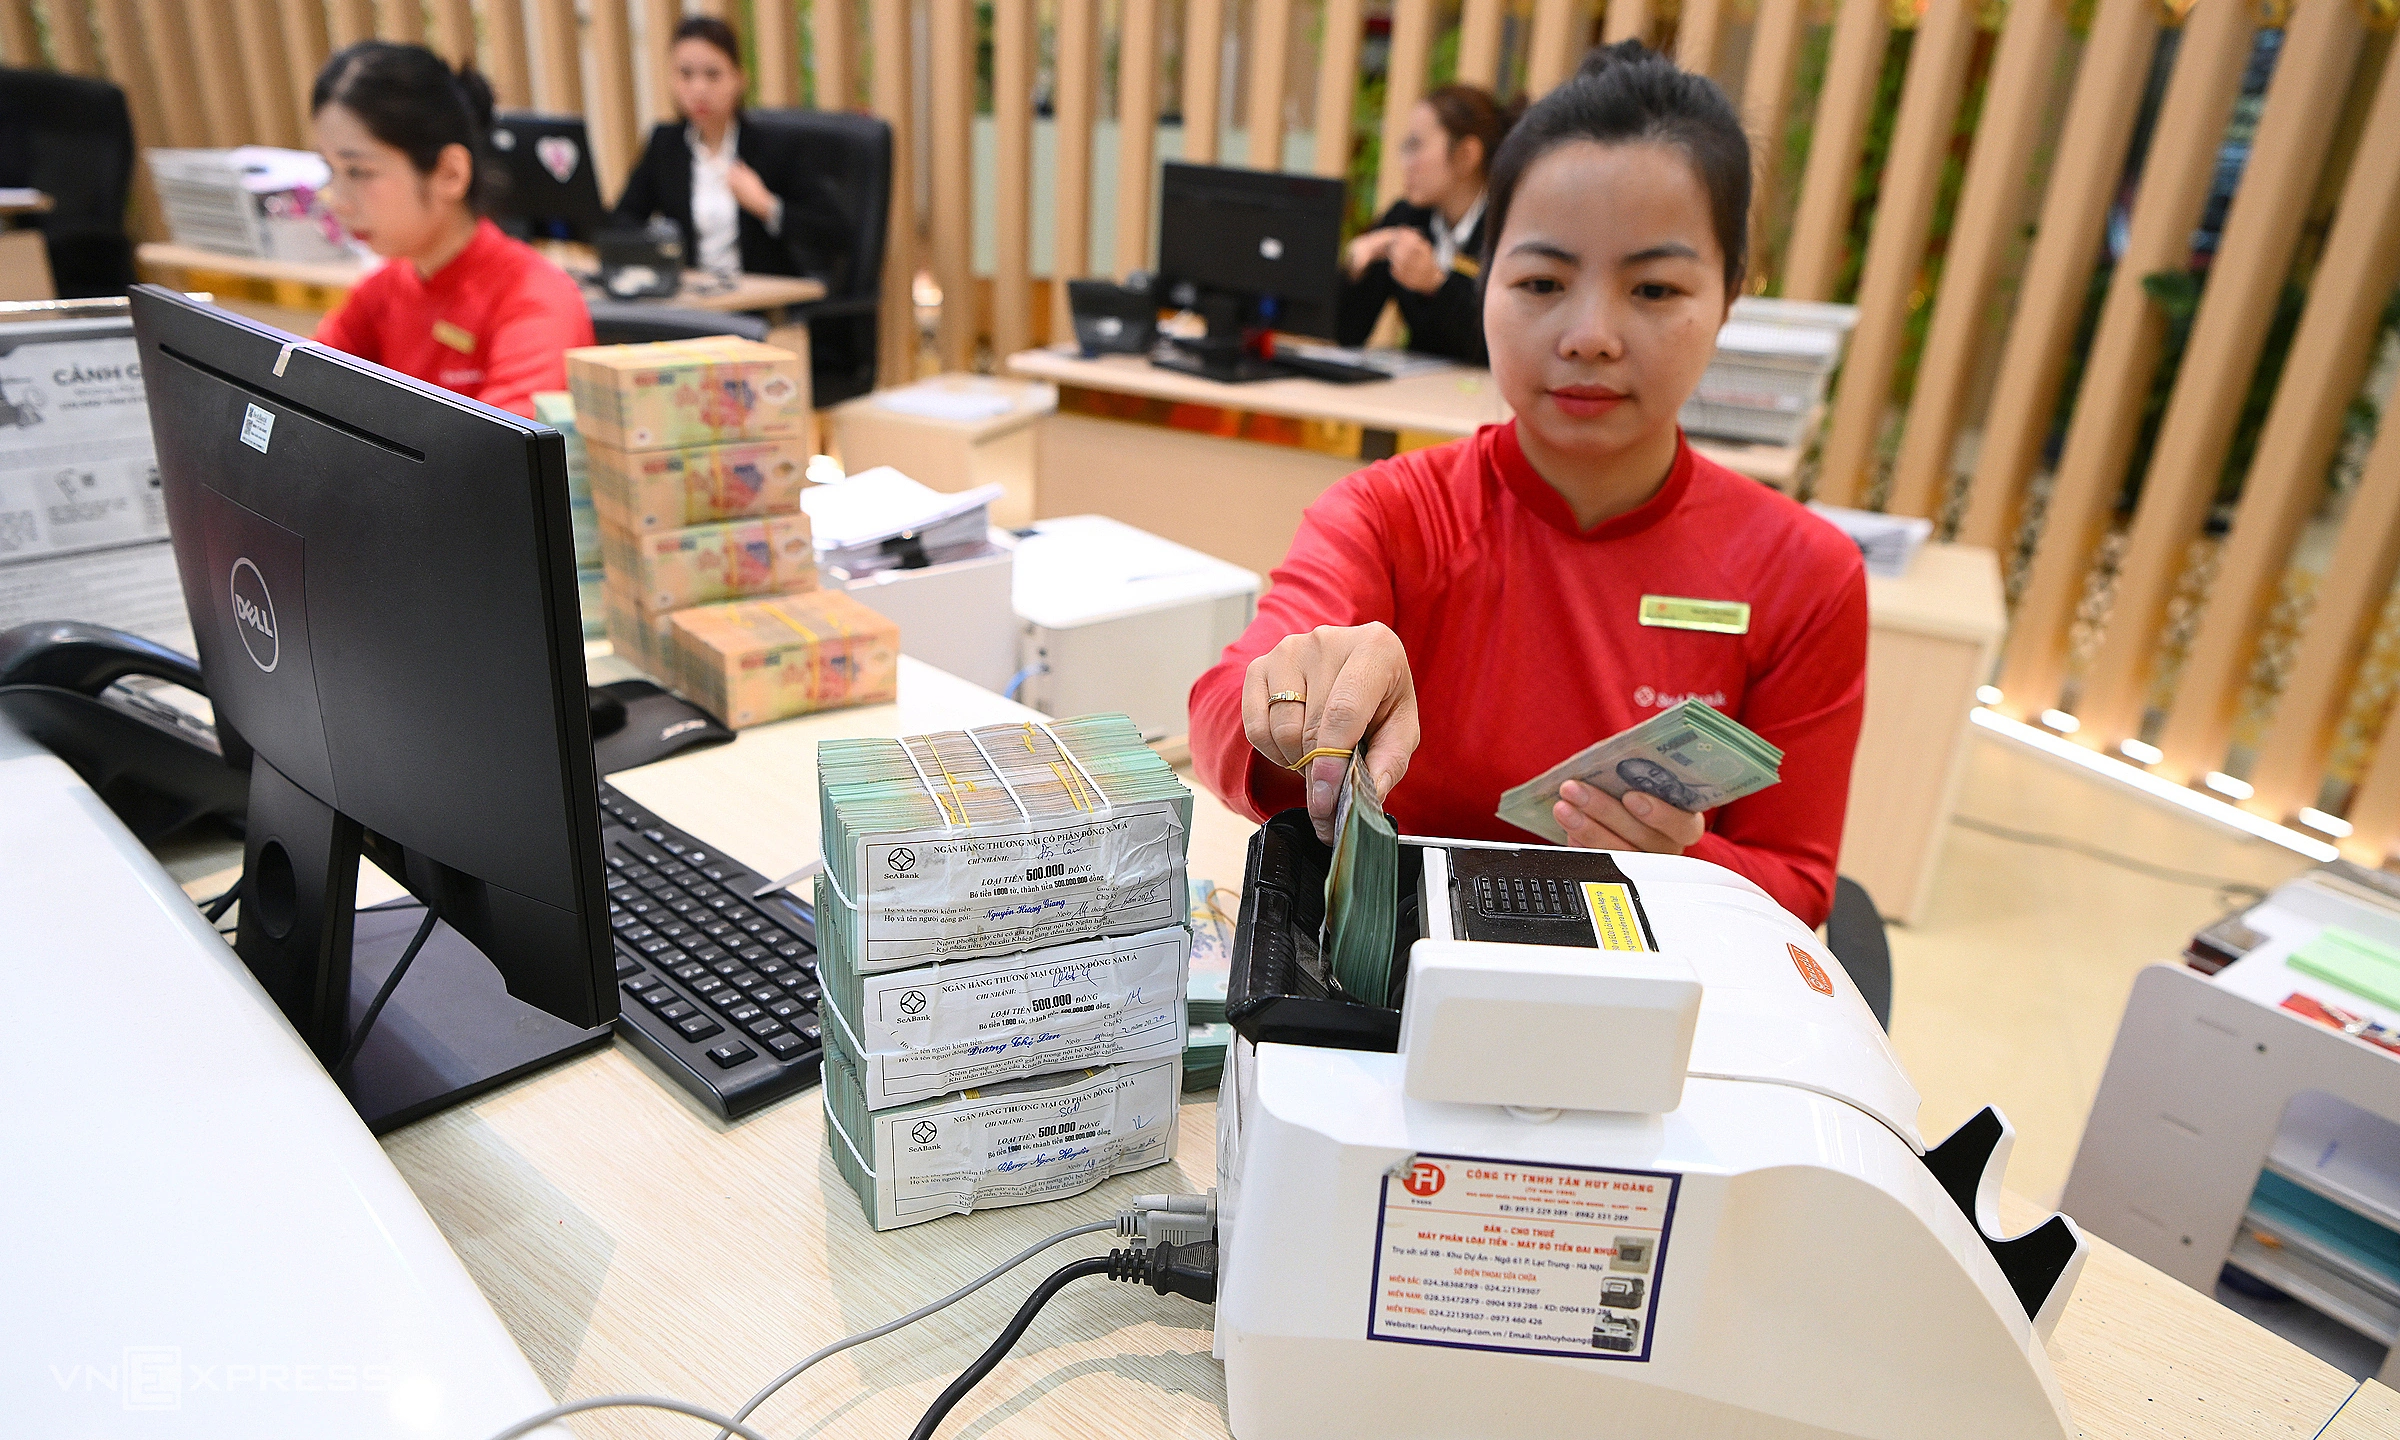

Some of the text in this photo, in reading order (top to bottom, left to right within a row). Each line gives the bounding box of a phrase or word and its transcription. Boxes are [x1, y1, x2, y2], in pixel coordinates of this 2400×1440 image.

[235, 593, 274, 638] DELL
[933, 845, 957, 854] NGÂN
[960, 842, 984, 852] HÀNG
[988, 840, 1024, 849] THƯƠNG
[1027, 837, 1040, 848] MẠI
[1082, 828, 1104, 837] ĐÔNG
[981, 863, 1092, 887] LOẠI TIỀN 500.000 ĐỒNG
[970, 890, 978, 899] Bó
[980, 885, 992, 897] tiền
[1009, 886, 1019, 895] tờ,
[1021, 884, 1040, 893] thành
[1041, 879, 1053, 891] tiền
[1054, 876, 1088, 887] 500.000.000
[884, 915, 895, 923] Họ
[919, 914, 939, 923] người
[940, 915, 956, 924] đóng
[958, 914, 971, 922] gói:
[983, 907, 1014, 921] Nguyễn
[1043, 899, 1066, 909] Giang
[942, 983, 966, 993] NGÂN
[968, 978, 993, 988] HÀNG
[995, 973, 1029, 985] THƯƠNG
[1031, 970, 1047, 978] MẠI
[1087, 958, 1111, 968] ĐÔNG
[1112, 954, 1131, 965] NAM
[976, 988, 1017, 1001] CHI NHÁNH:
[991, 993, 1098, 1019] LOẠI TIỀN 500.000 ĐỒNG
[896, 1014, 931, 1024] SeABank
[989, 1019, 1000, 1028] tiền
[967, 1032, 1061, 1056] Dương Thị Lan
[954, 1112, 976, 1124] NGÂN
[978, 1108, 1001, 1118] HÀNG
[1004, 1103, 1038, 1113] THƯƠNG
[1040, 1100, 1057, 1109] MẠI
[1093, 1087, 1114, 1098] ĐÔNG
[997, 1120, 1101, 1145] LOẠI TIỀN 500.000 ĐỒNG
[908, 1143, 942, 1153] SeABank
[988, 1151, 995, 1159] Bó
[997, 1146, 1007, 1156] tiền
[1032, 1140, 1051, 1148] thành
[1052, 1136, 1063, 1145] tiền
[1065, 1131, 1096, 1142] 500.000.000
[1466, 1169, 1654, 1193] CÔNG TY TNHH TÂN HUY HOÀNG
[1483, 1224, 1501, 1233] BÁN
[1511, 1226, 1529, 1236] CHO
[1418, 1231, 1437, 1240] MÁY
[1440, 1232, 1463, 1243] PHÂN
[1466, 1235, 1486, 1246] LOẠI
[1488, 1236, 1508, 1247] TIỀN
[1517, 1239, 1536, 1249] MÁY
[1554, 1242, 1573, 1252] TIỀN
[1594, 1247, 1618, 1257] NHỰA
[1464, 1253, 1476, 1261] Dự
[1477, 1253, 1489, 1261] Án
[1547, 1258, 1570, 1269] Trung
[1385, 1319, 1533, 1340] Website: tanhuyhoang.com.vn Email:
